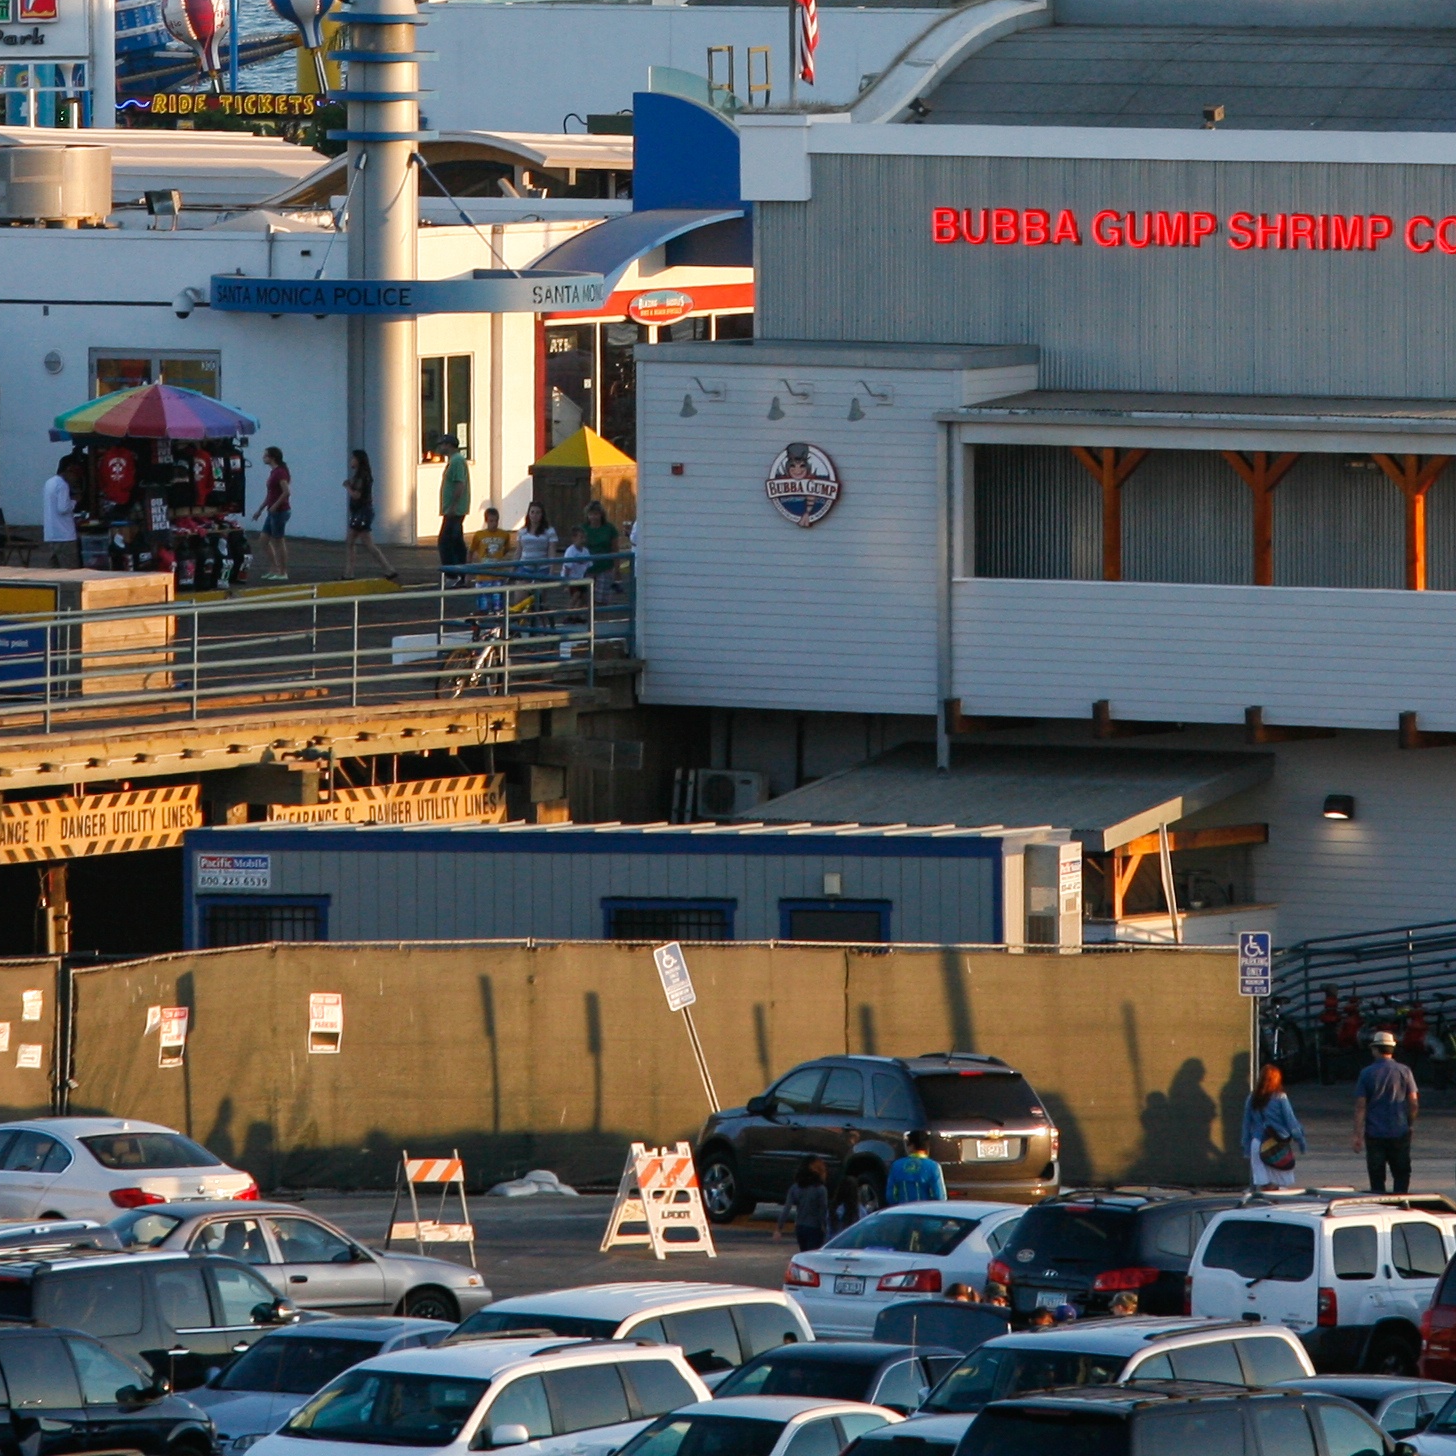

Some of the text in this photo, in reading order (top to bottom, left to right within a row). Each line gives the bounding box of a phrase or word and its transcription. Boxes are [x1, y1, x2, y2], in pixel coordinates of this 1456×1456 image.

[151, 93, 316, 115] RIDE TICKETS
[932, 206, 1081, 246] BUBBA
[1092, 209, 1218, 248] GUMP
[1228, 211, 1394, 252] SHRIMP
[216, 285, 412, 306] SANTA MONICA POLICE
[532, 285, 580, 304] SANTA
[768, 480, 837, 497] BUBBA GUMP
[368, 800, 412, 823] DANGER
[416, 795, 460, 822] UTILITY
[464, 792, 497, 816] LINES
[60, 812, 107, 840] DANGER
[112, 807, 156, 835] UTILITY
[161, 803, 194, 829] LINES
[201, 858, 268, 869] Pacific Mobile
[1241, 958, 1268, 966] PARKING
[1246, 966, 1263, 977] ONLY
